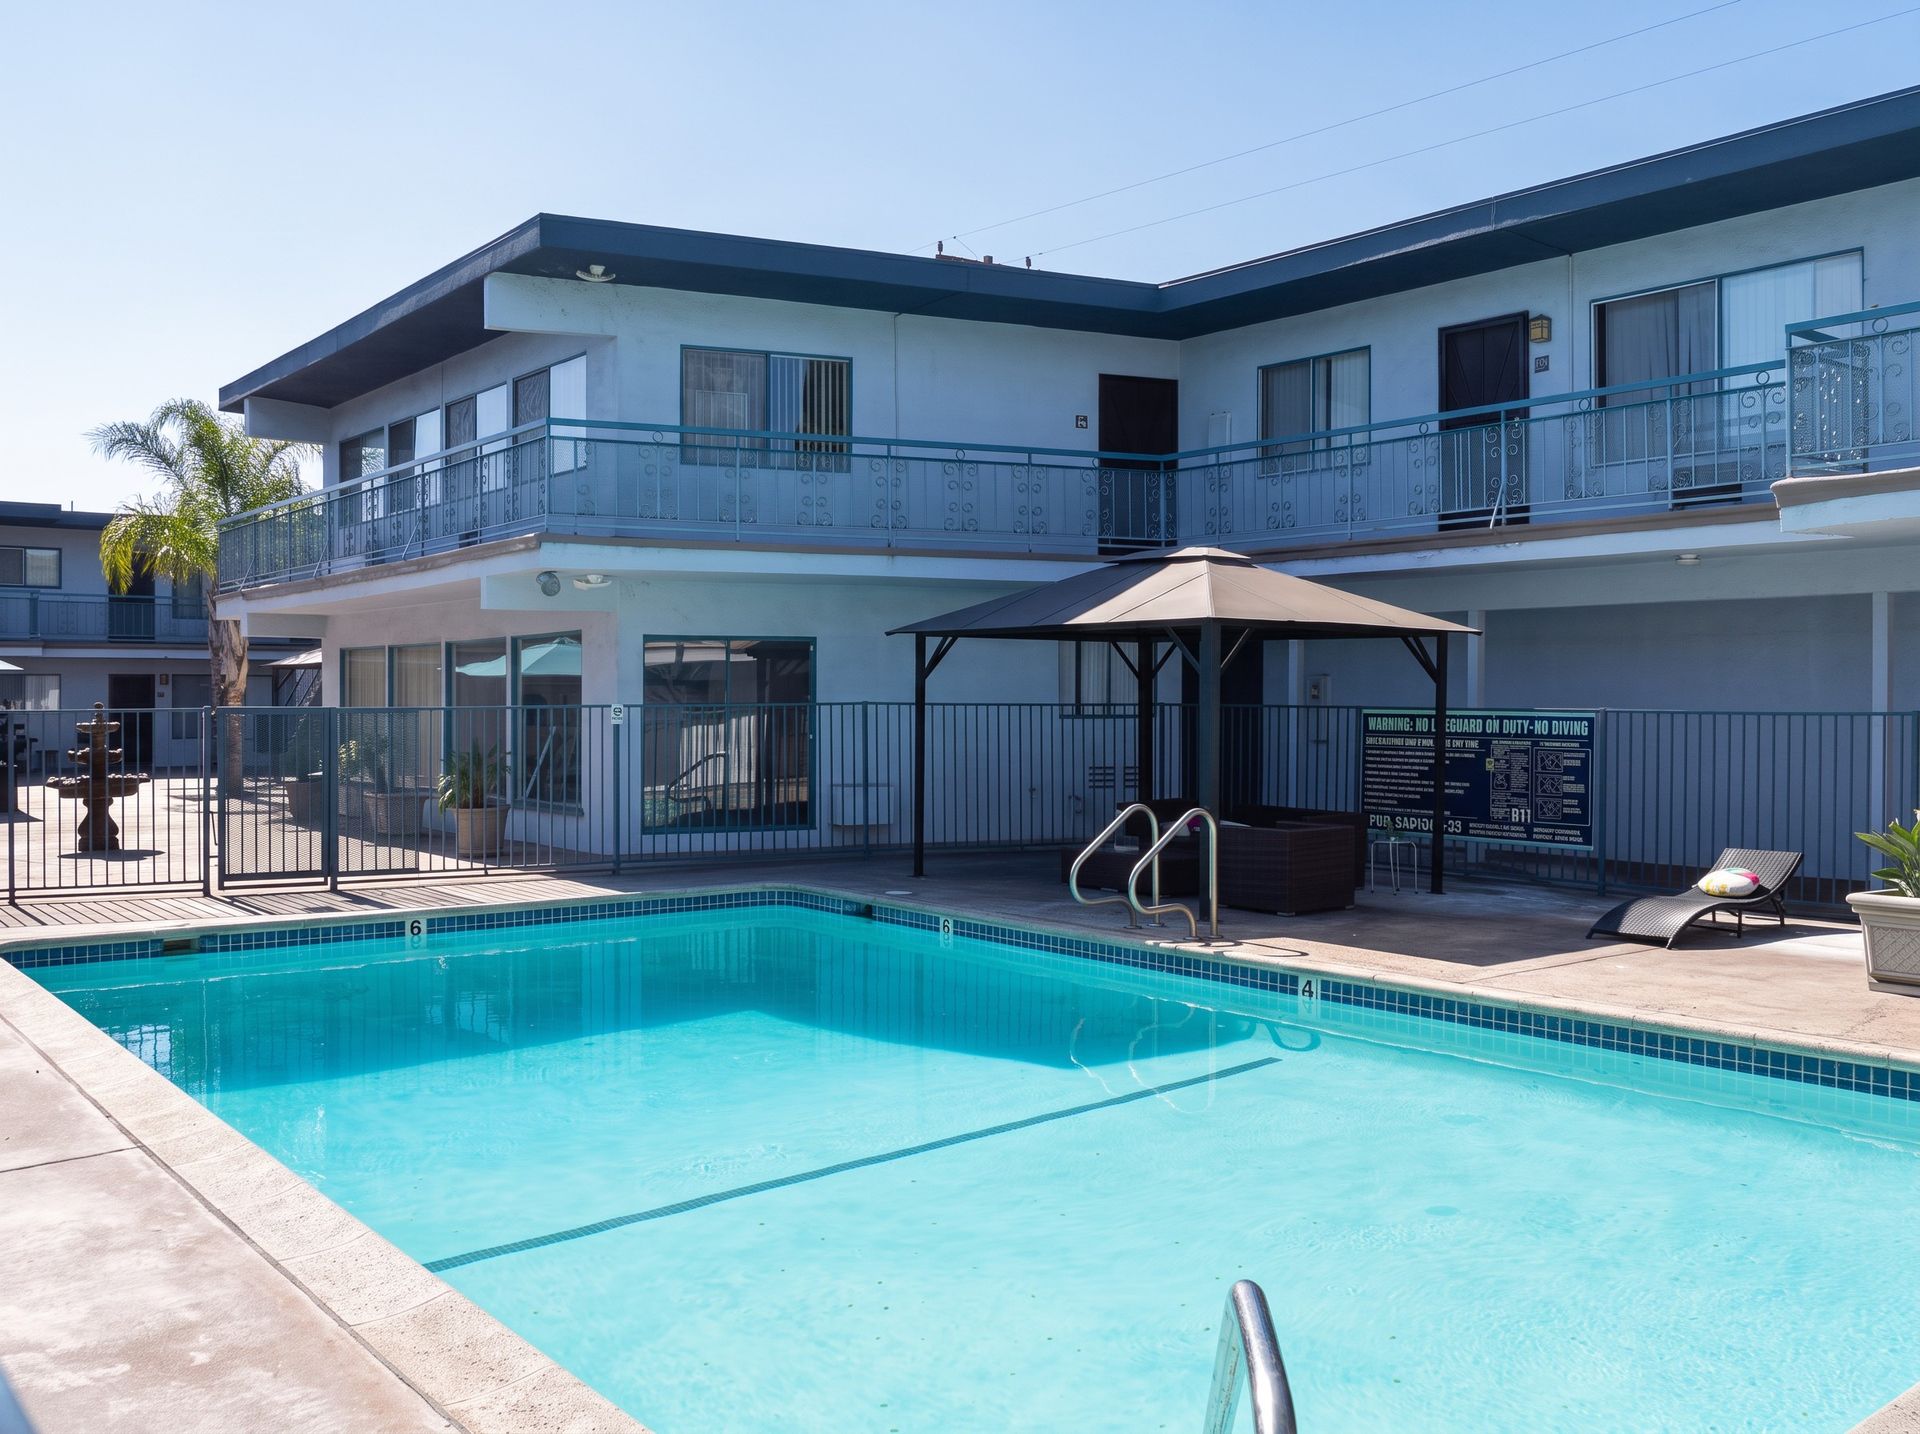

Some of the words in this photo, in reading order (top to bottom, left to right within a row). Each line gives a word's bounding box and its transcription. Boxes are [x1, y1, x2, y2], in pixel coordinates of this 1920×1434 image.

[1368, 717, 1413, 732] WARNING:
[1415, 718, 1429, 732] NO
[1431, 718, 1483, 733] LEGUARD
[1485, 719, 1500, 734] ON
[1551, 720, 1589, 736] DIVING
[410, 920, 422, 936] 6
[943, 918, 950, 933] 6
[1301, 979, 1314, 998] 4
